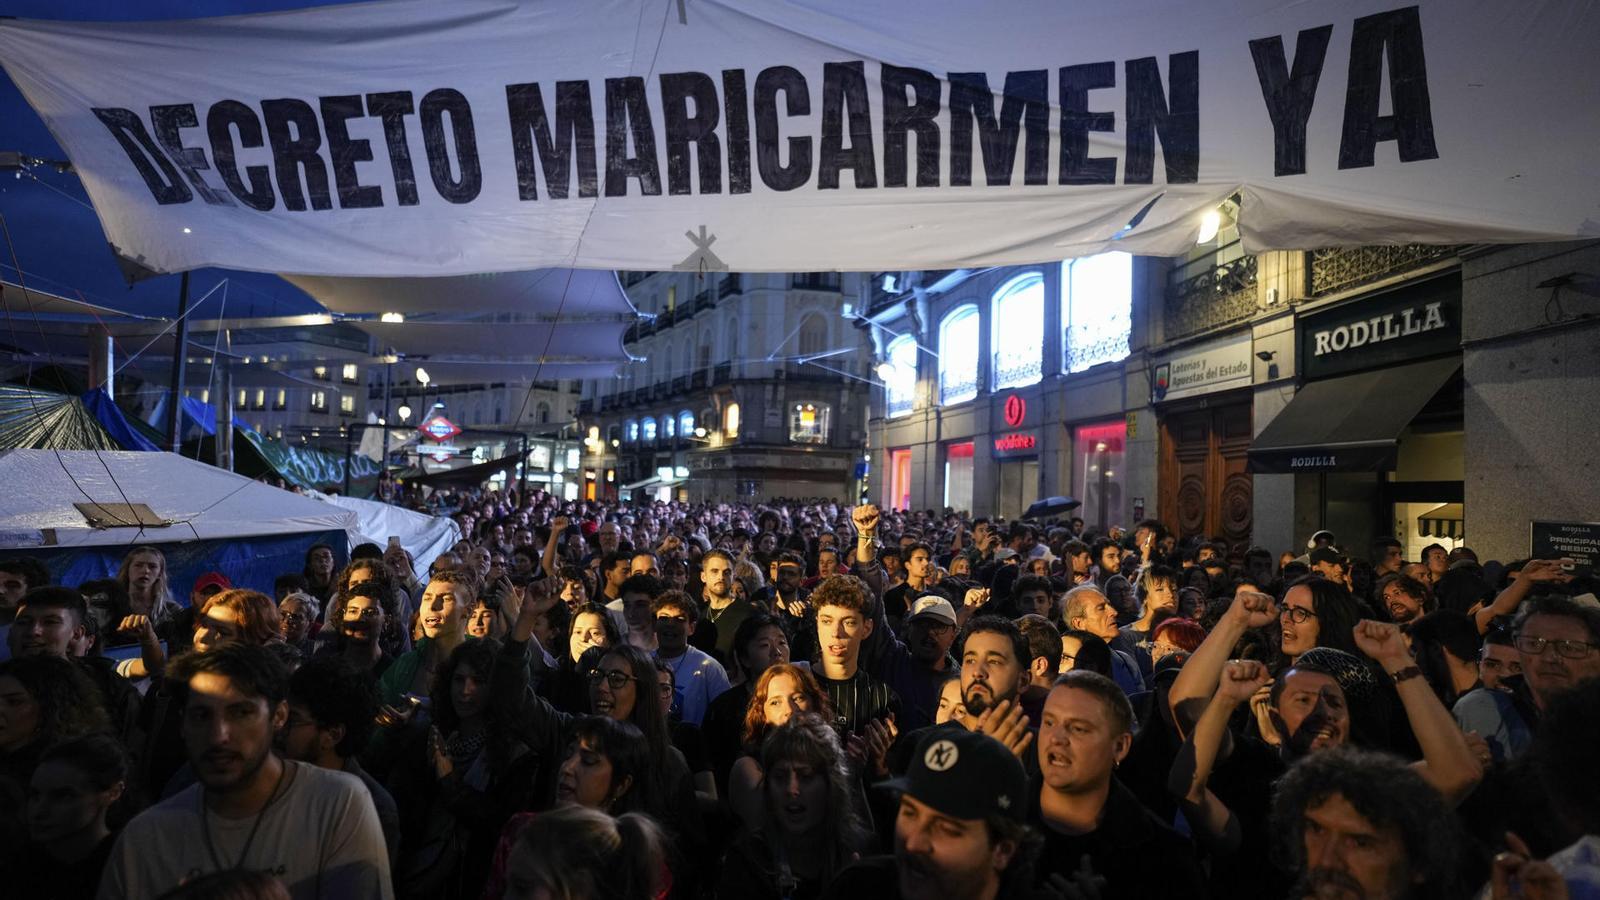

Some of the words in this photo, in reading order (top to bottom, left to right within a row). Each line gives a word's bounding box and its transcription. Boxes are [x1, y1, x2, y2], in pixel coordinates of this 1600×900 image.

[91, 87, 482, 212] DECRETO
[506, 50, 1199, 201] MARICARMEN
[1247, 4, 1440, 178] YA
[1314, 301, 1446, 356] RODILLA
[1172, 373, 1204, 387] Apuestas
[1206, 366, 1218, 379] del
[1219, 361, 1247, 376] Estado
[1202, 360, 1206, 370] y
[1291, 456, 1336, 467] RODILLA
